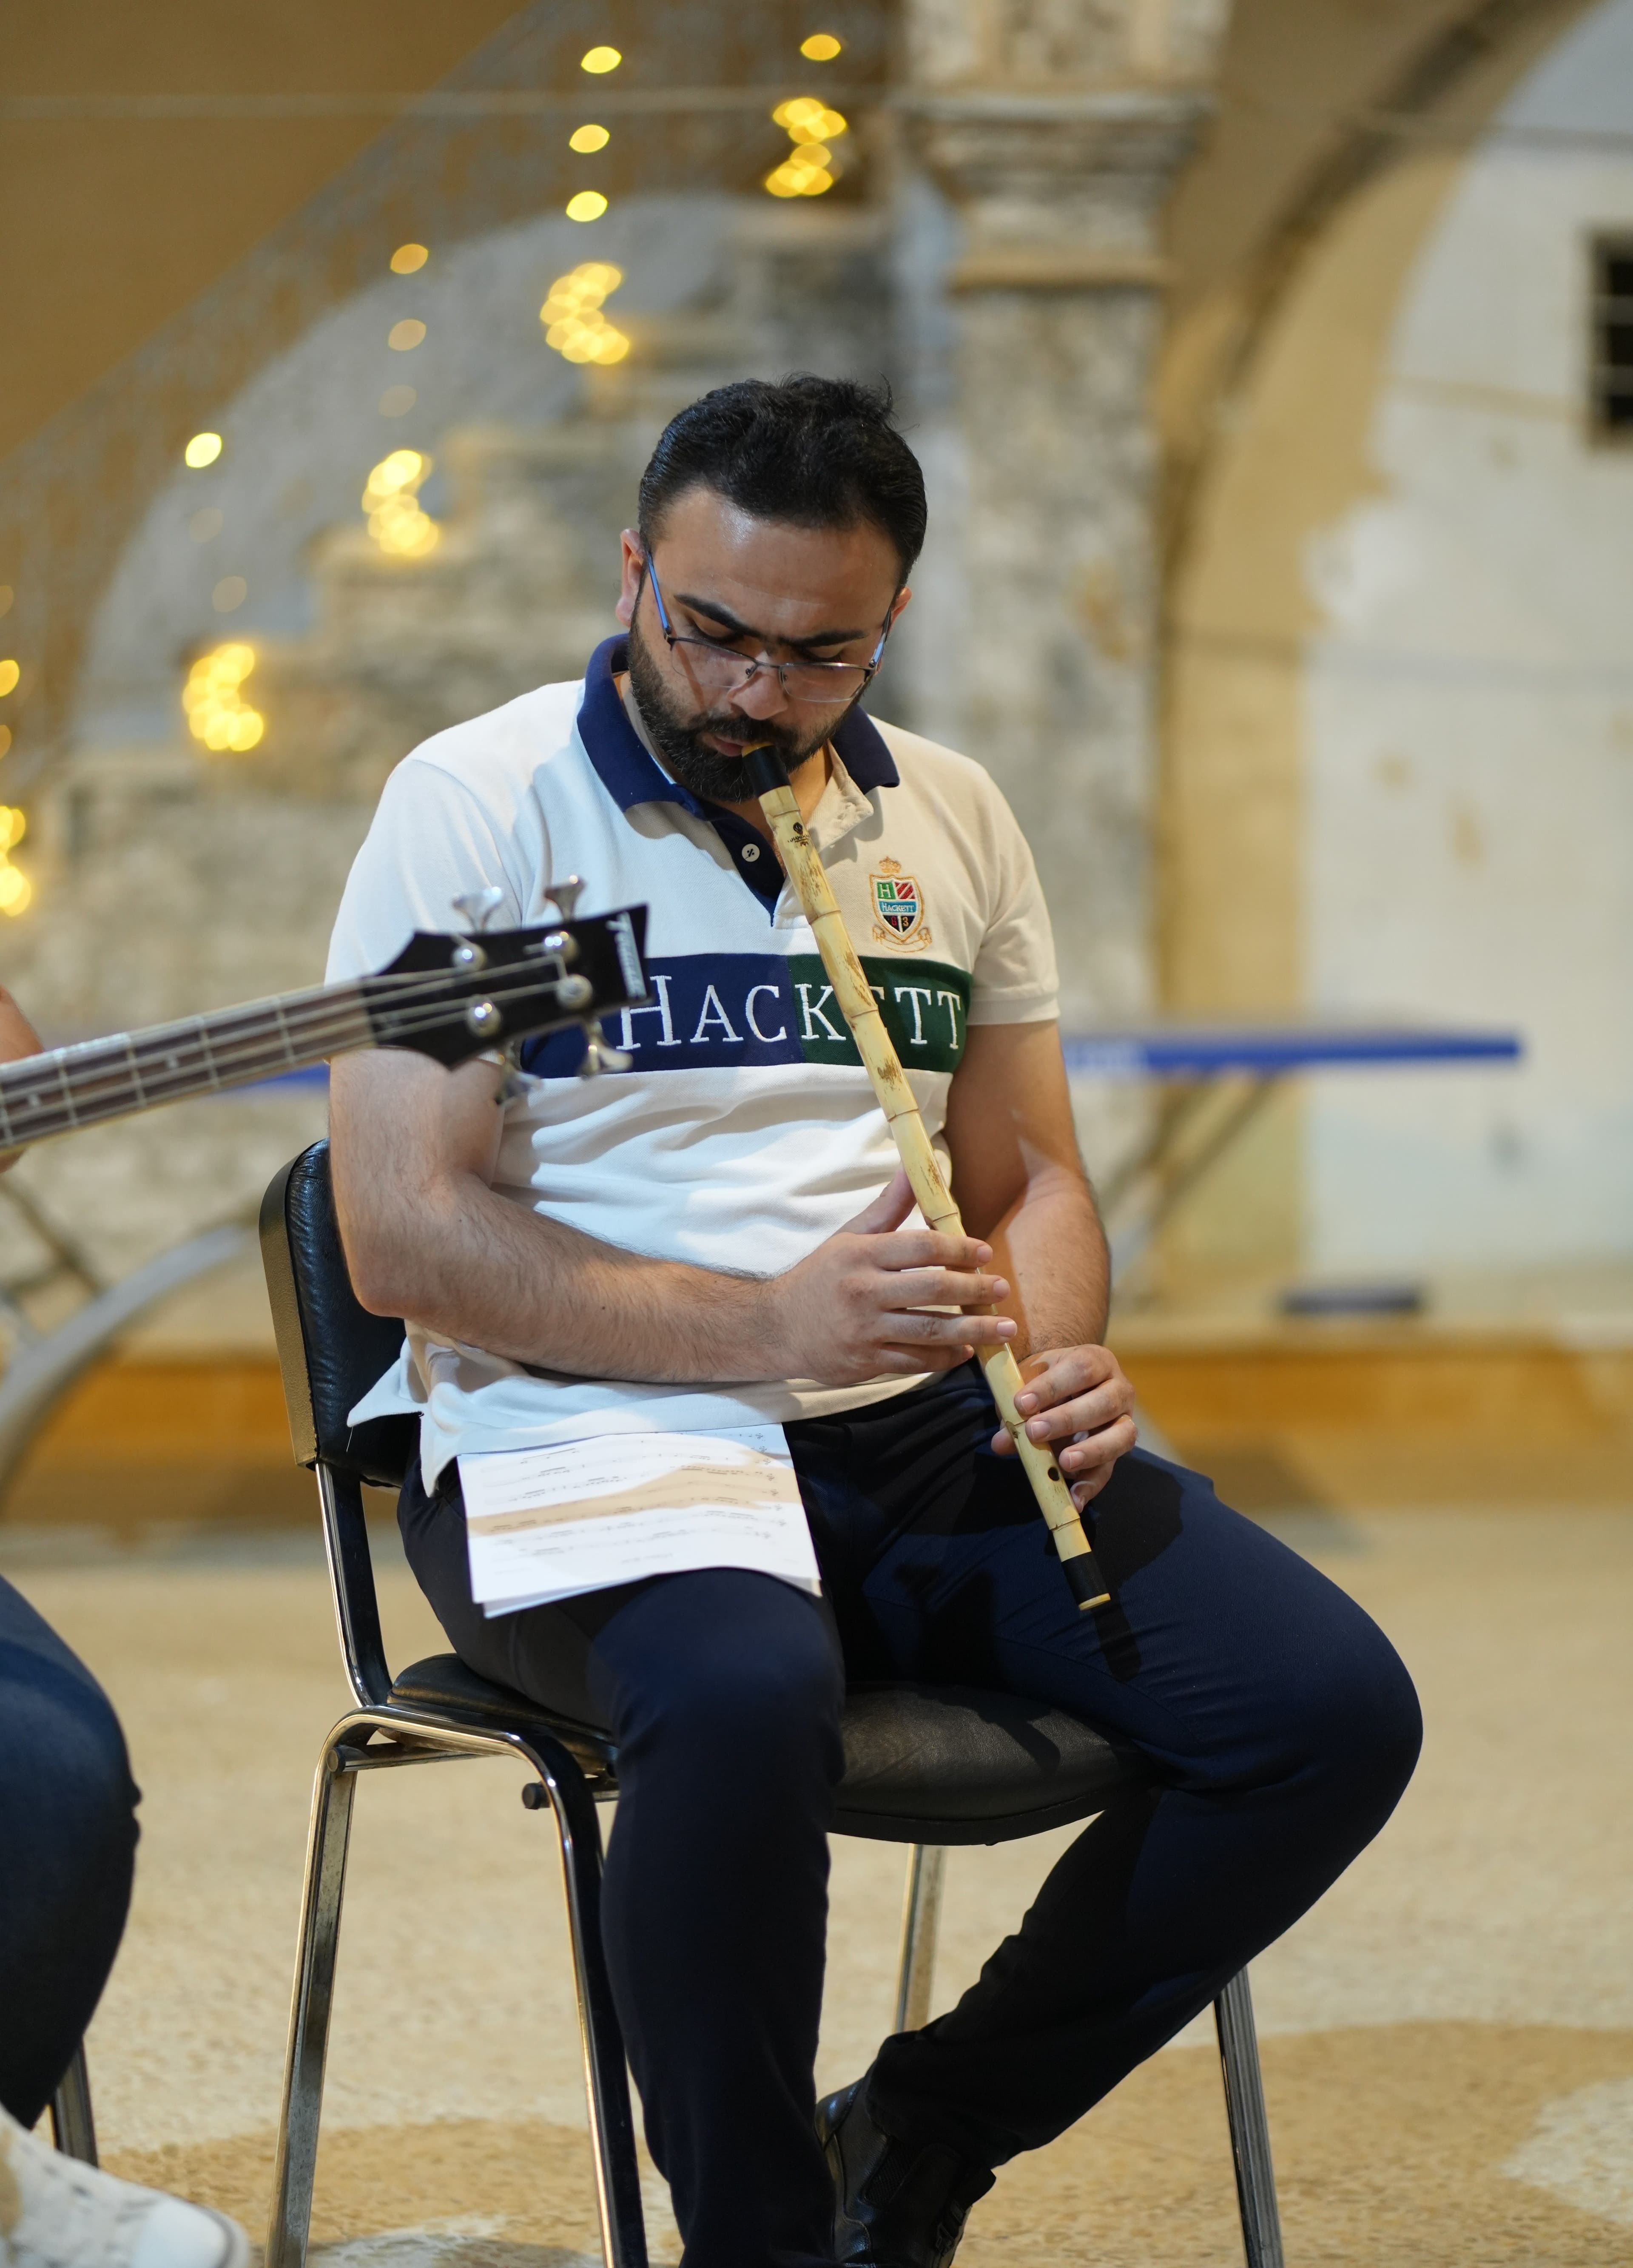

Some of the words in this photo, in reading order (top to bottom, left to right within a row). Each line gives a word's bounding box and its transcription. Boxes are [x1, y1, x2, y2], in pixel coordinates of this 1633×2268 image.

[880, 884, 891, 898] H
[881, 902, 914, 912] HACKETT
[616, 975, 962, 1050] HACKTT
